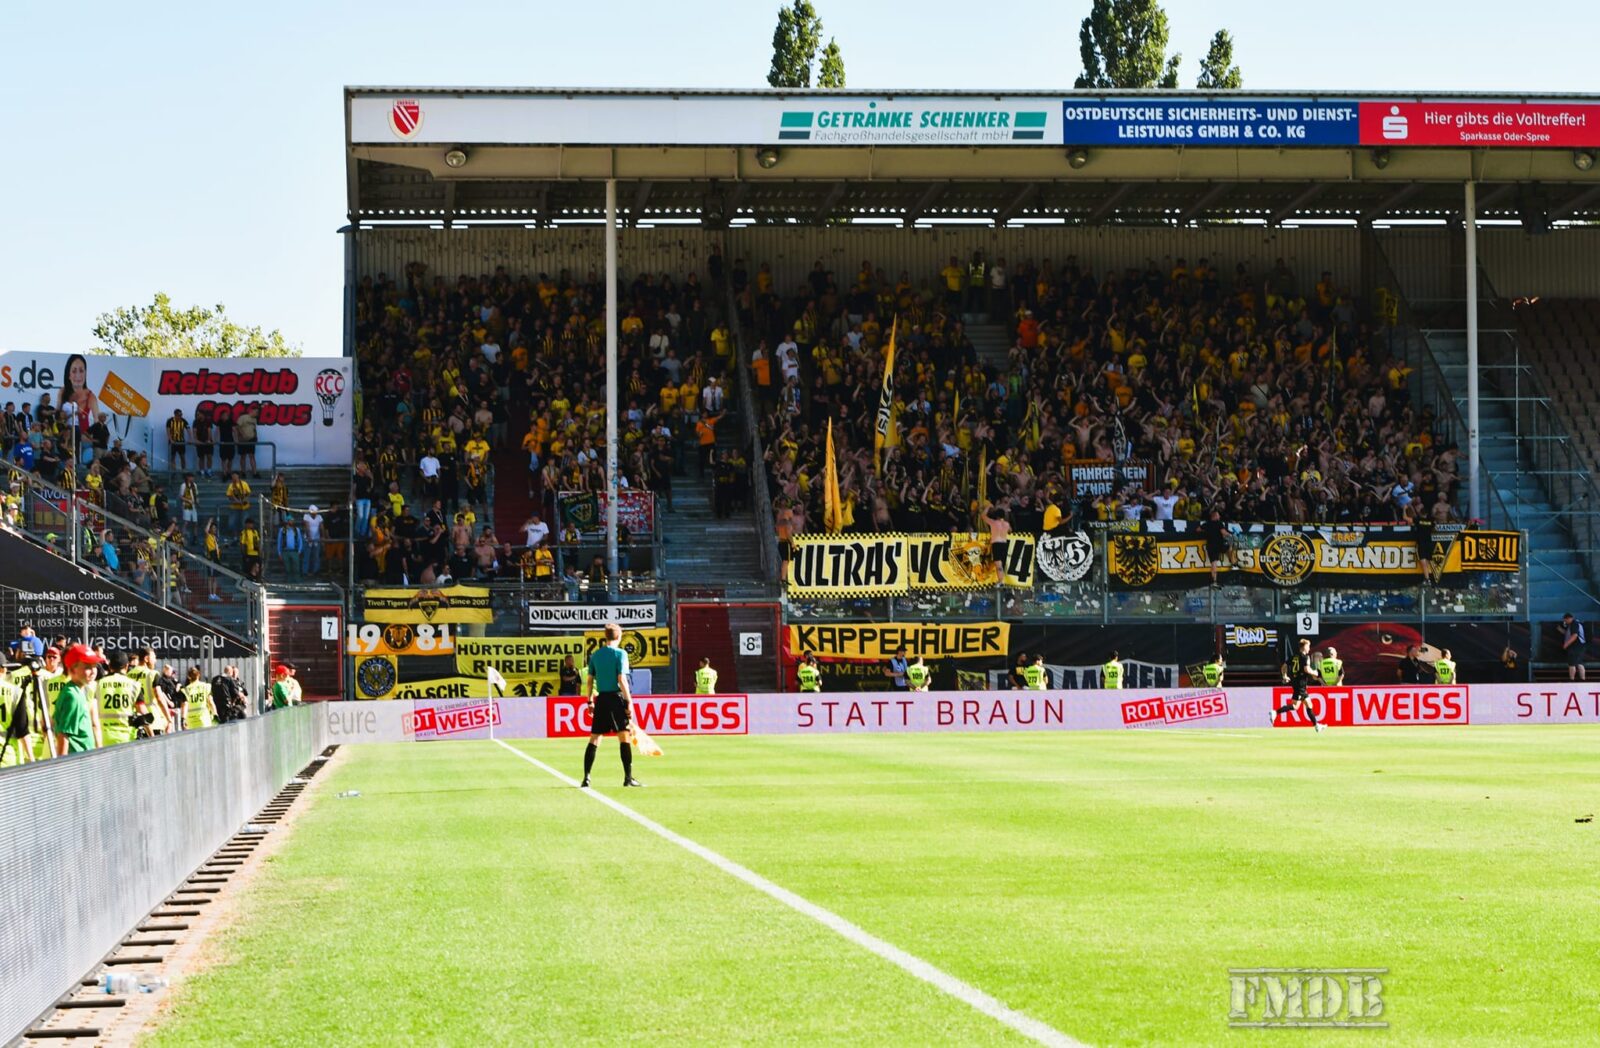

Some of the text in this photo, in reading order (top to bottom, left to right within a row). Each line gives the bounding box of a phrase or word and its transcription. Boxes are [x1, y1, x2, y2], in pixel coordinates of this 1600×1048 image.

[919, 111, 1010, 128] SCHENKER
[1065, 107, 1357, 121] OSTDEUTSCHE SICHERHEITS- UND DIENST-
[1425, 111, 1586, 127] Hier gibts die Volltreffer!
[814, 130, 1009, 143] Fachgroßhandelsgesellschaft mbH
[1118, 124, 1306, 138] LEISTUNGS GMBH & CO. KG
[1460, 131, 1550, 142] Sparkasse Oder-Spree
[159, 369, 299, 395] Reiseclub
[316, 375, 344, 394] RCC
[794, 541, 903, 586] ULTRAS
[1160, 544, 1417, 568] KAS BANDE
[18, 591, 115, 600] WaschSalon Cottbus
[18, 605, 33, 614] Am
[36, 604, 58, 614] Gleis
[72, 604, 99, 614] 0342
[102, 604, 138, 614] Cottbus
[19, 619, 35, 627] Tel.
[38, 619, 65, 628] (0355)
[69, 619, 85, 627] 756
[104, 619, 120, 627] 251
[327, 621, 333, 637] 7
[1302, 616, 1312, 631] 9
[347, 624, 454, 653] 19 81
[649, 636, 669, 657] 15
[747, 636, 755, 651] 8
[798, 621, 1001, 655] KAPPEHÄUER
[458, 642, 583, 655] HÜRTGENWALD
[104, 693, 129, 709] 268
[1126, 697, 1224, 720] ROT WEISS
[1357, 692, 1462, 720] WEISS
[437, 706, 498, 732] WEISS
[634, 702, 740, 730] WEISS
[797, 699, 1063, 727] STATT BRAUN
[328, 708, 377, 736] eure
